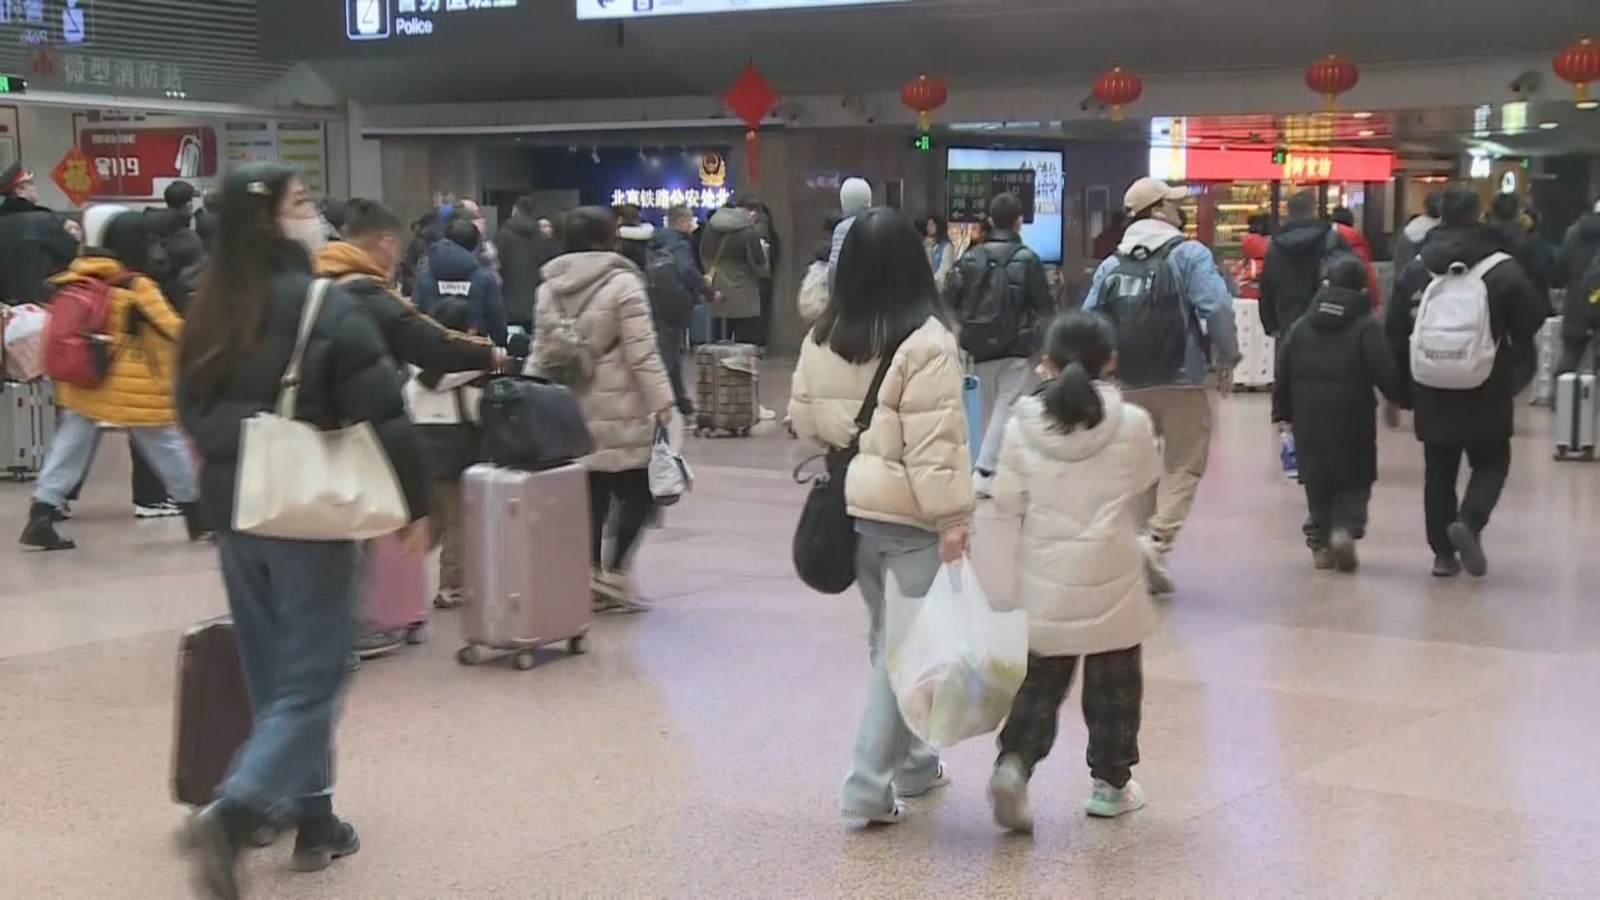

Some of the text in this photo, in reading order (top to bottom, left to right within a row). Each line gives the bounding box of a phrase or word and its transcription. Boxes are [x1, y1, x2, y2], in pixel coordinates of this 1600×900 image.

[396, 18, 433, 35] Police
[65, 54, 182, 90] 微型消防站
[111, 157, 140, 176] 119
[611, 188, 734, 208] 北京铁路公安处北
